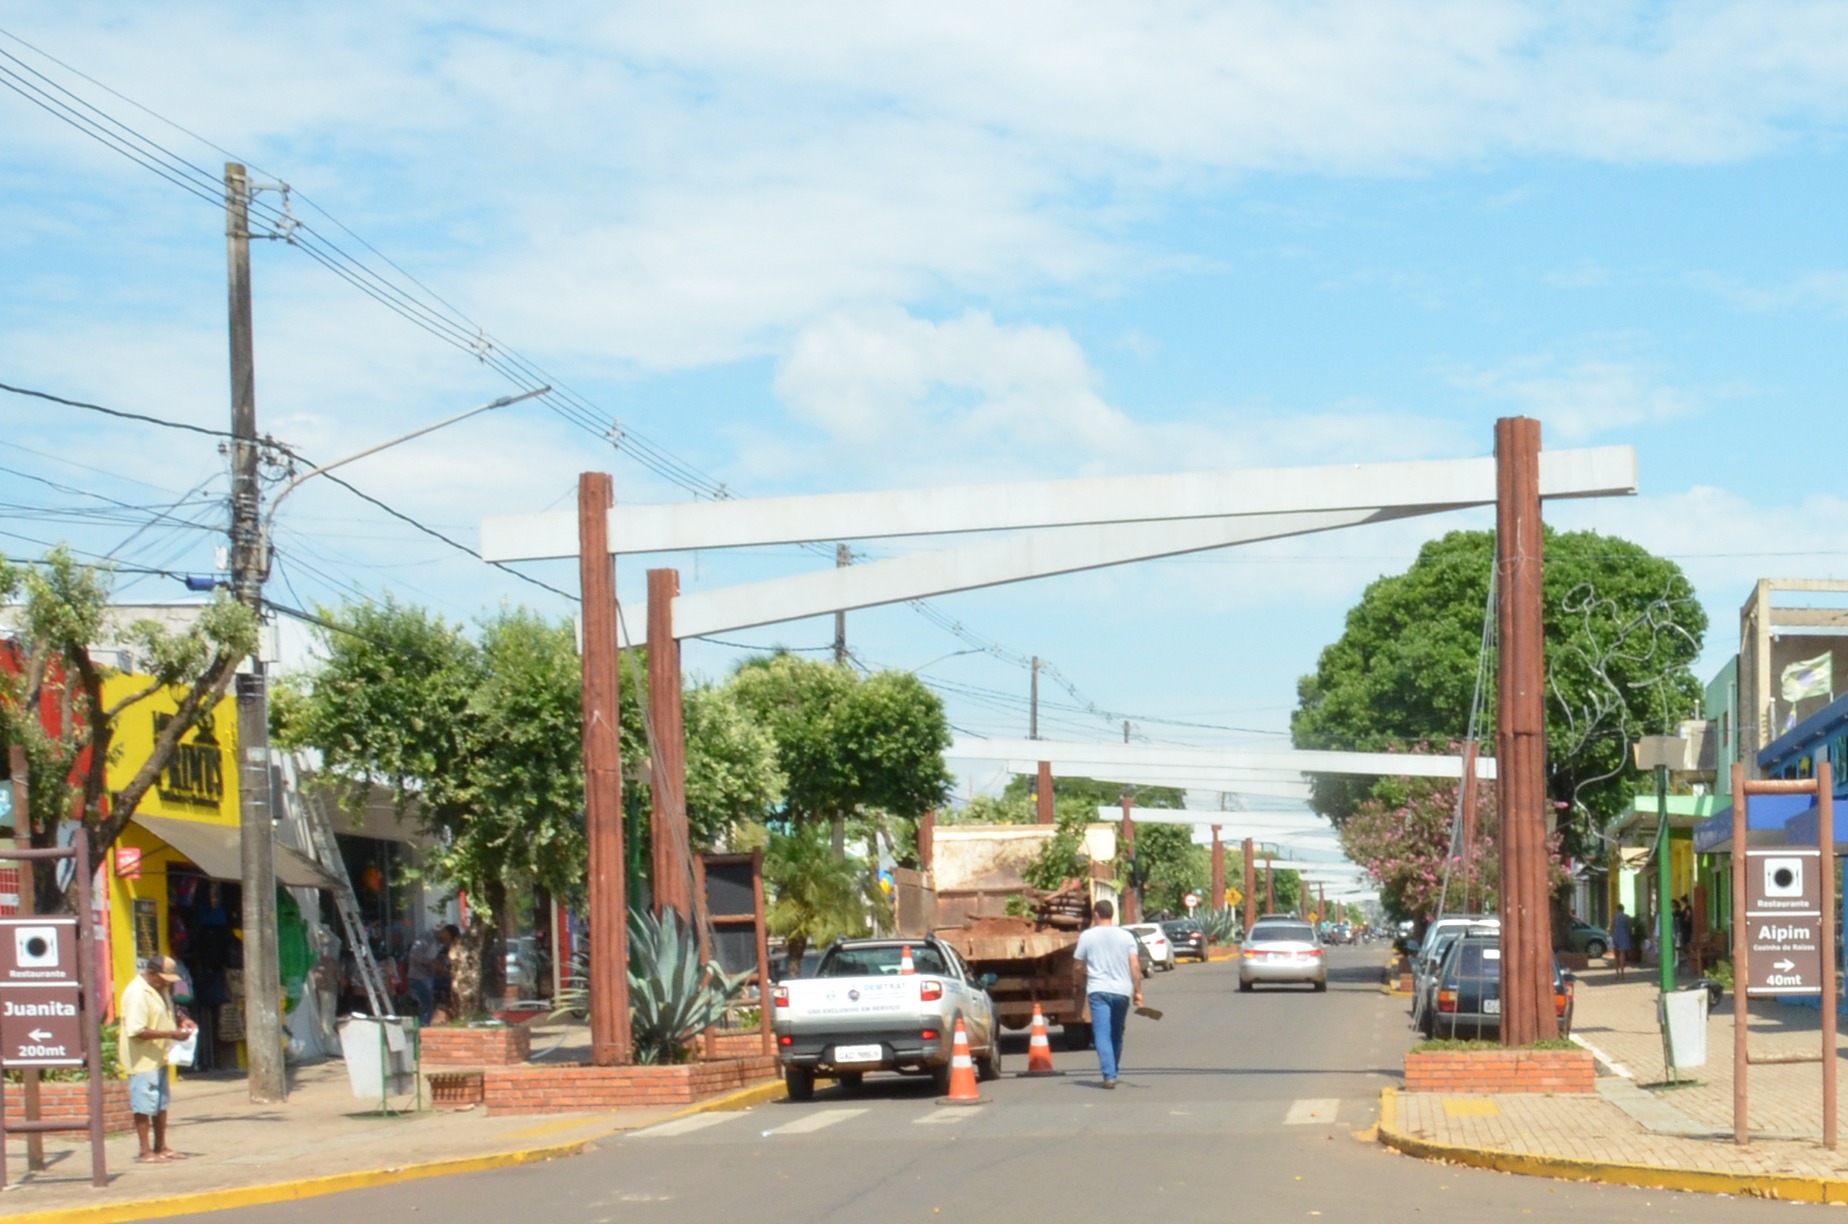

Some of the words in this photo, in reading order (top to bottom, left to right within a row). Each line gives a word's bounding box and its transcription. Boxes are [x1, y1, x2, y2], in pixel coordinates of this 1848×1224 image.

[1757, 899, 1810, 908] Restaurante
[1758, 925, 1810, 942] Aipim
[9, 969, 66, 978] Restaurante
[1766, 974, 1802, 986] 40mt
[3, 1001, 76, 1017] Juanita
[18, 1045, 66, 1057] 200mt
